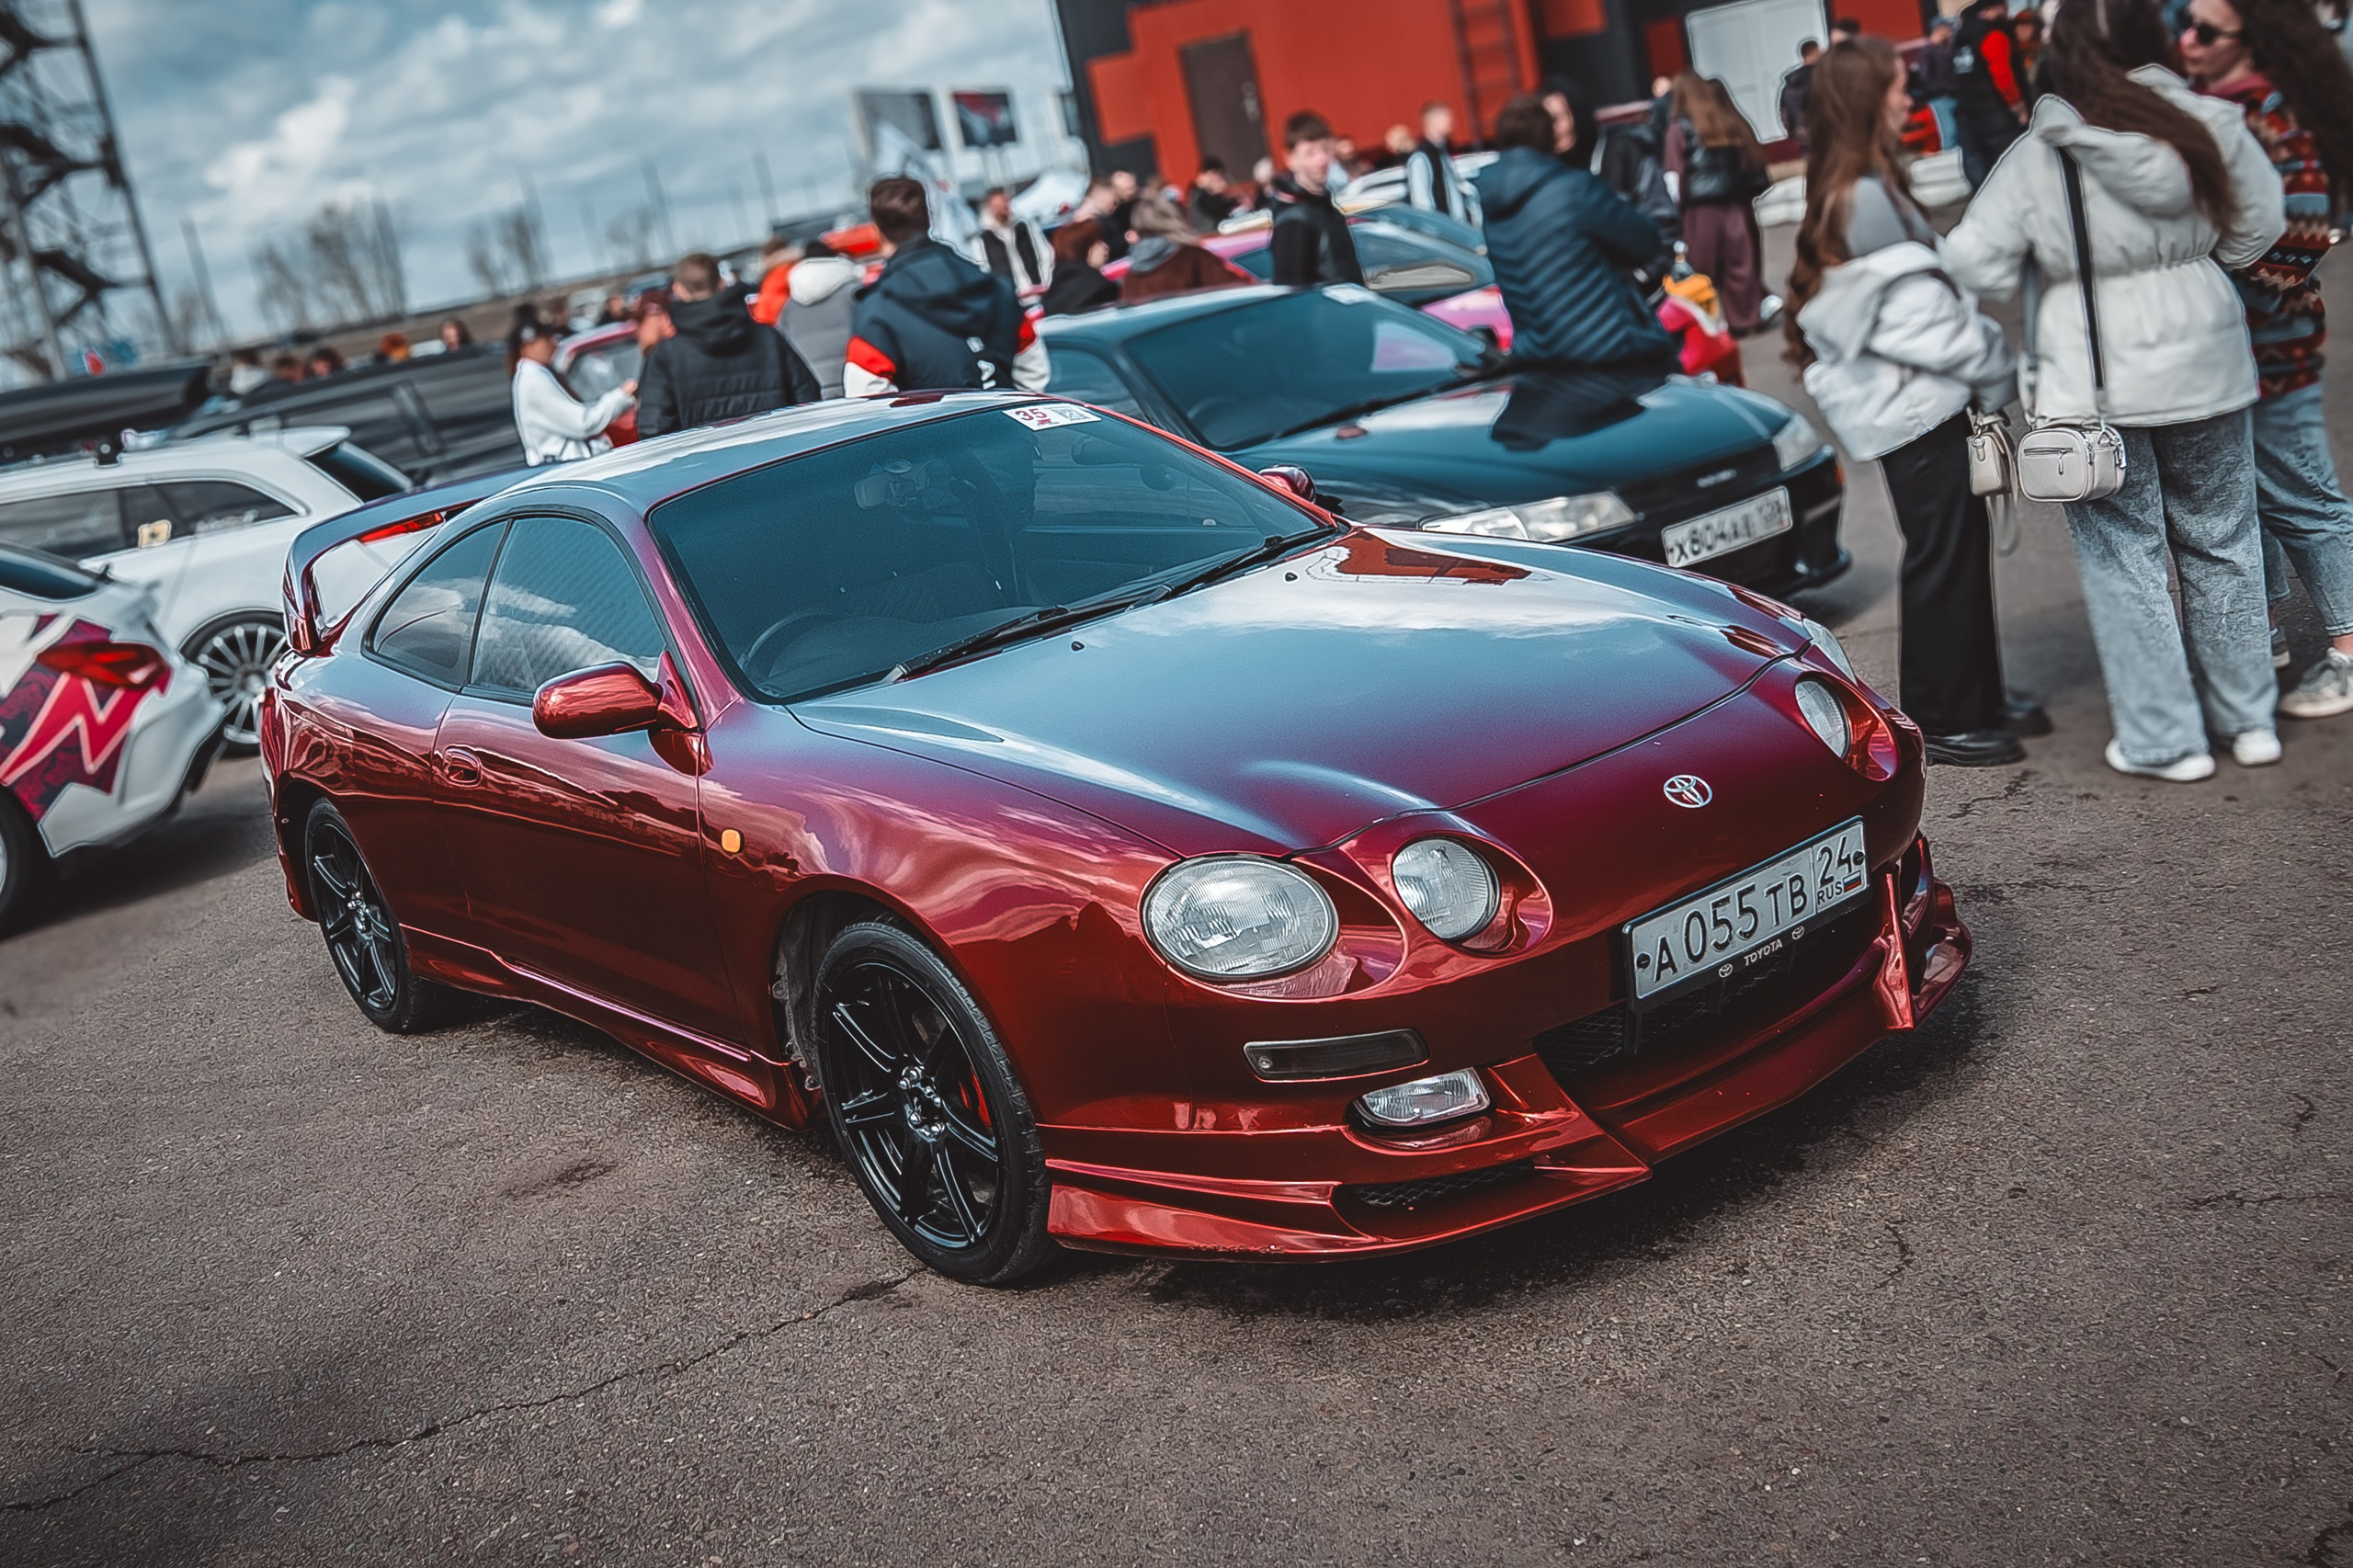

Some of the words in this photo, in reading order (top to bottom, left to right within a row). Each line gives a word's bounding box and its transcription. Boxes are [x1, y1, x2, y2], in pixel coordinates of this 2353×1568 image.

[1015, 408, 1048, 421] 35
[1817, 835, 1852, 889] 24
[1817, 881, 1844, 906] RUS
[1744, 938, 1783, 967] TOYOTA
